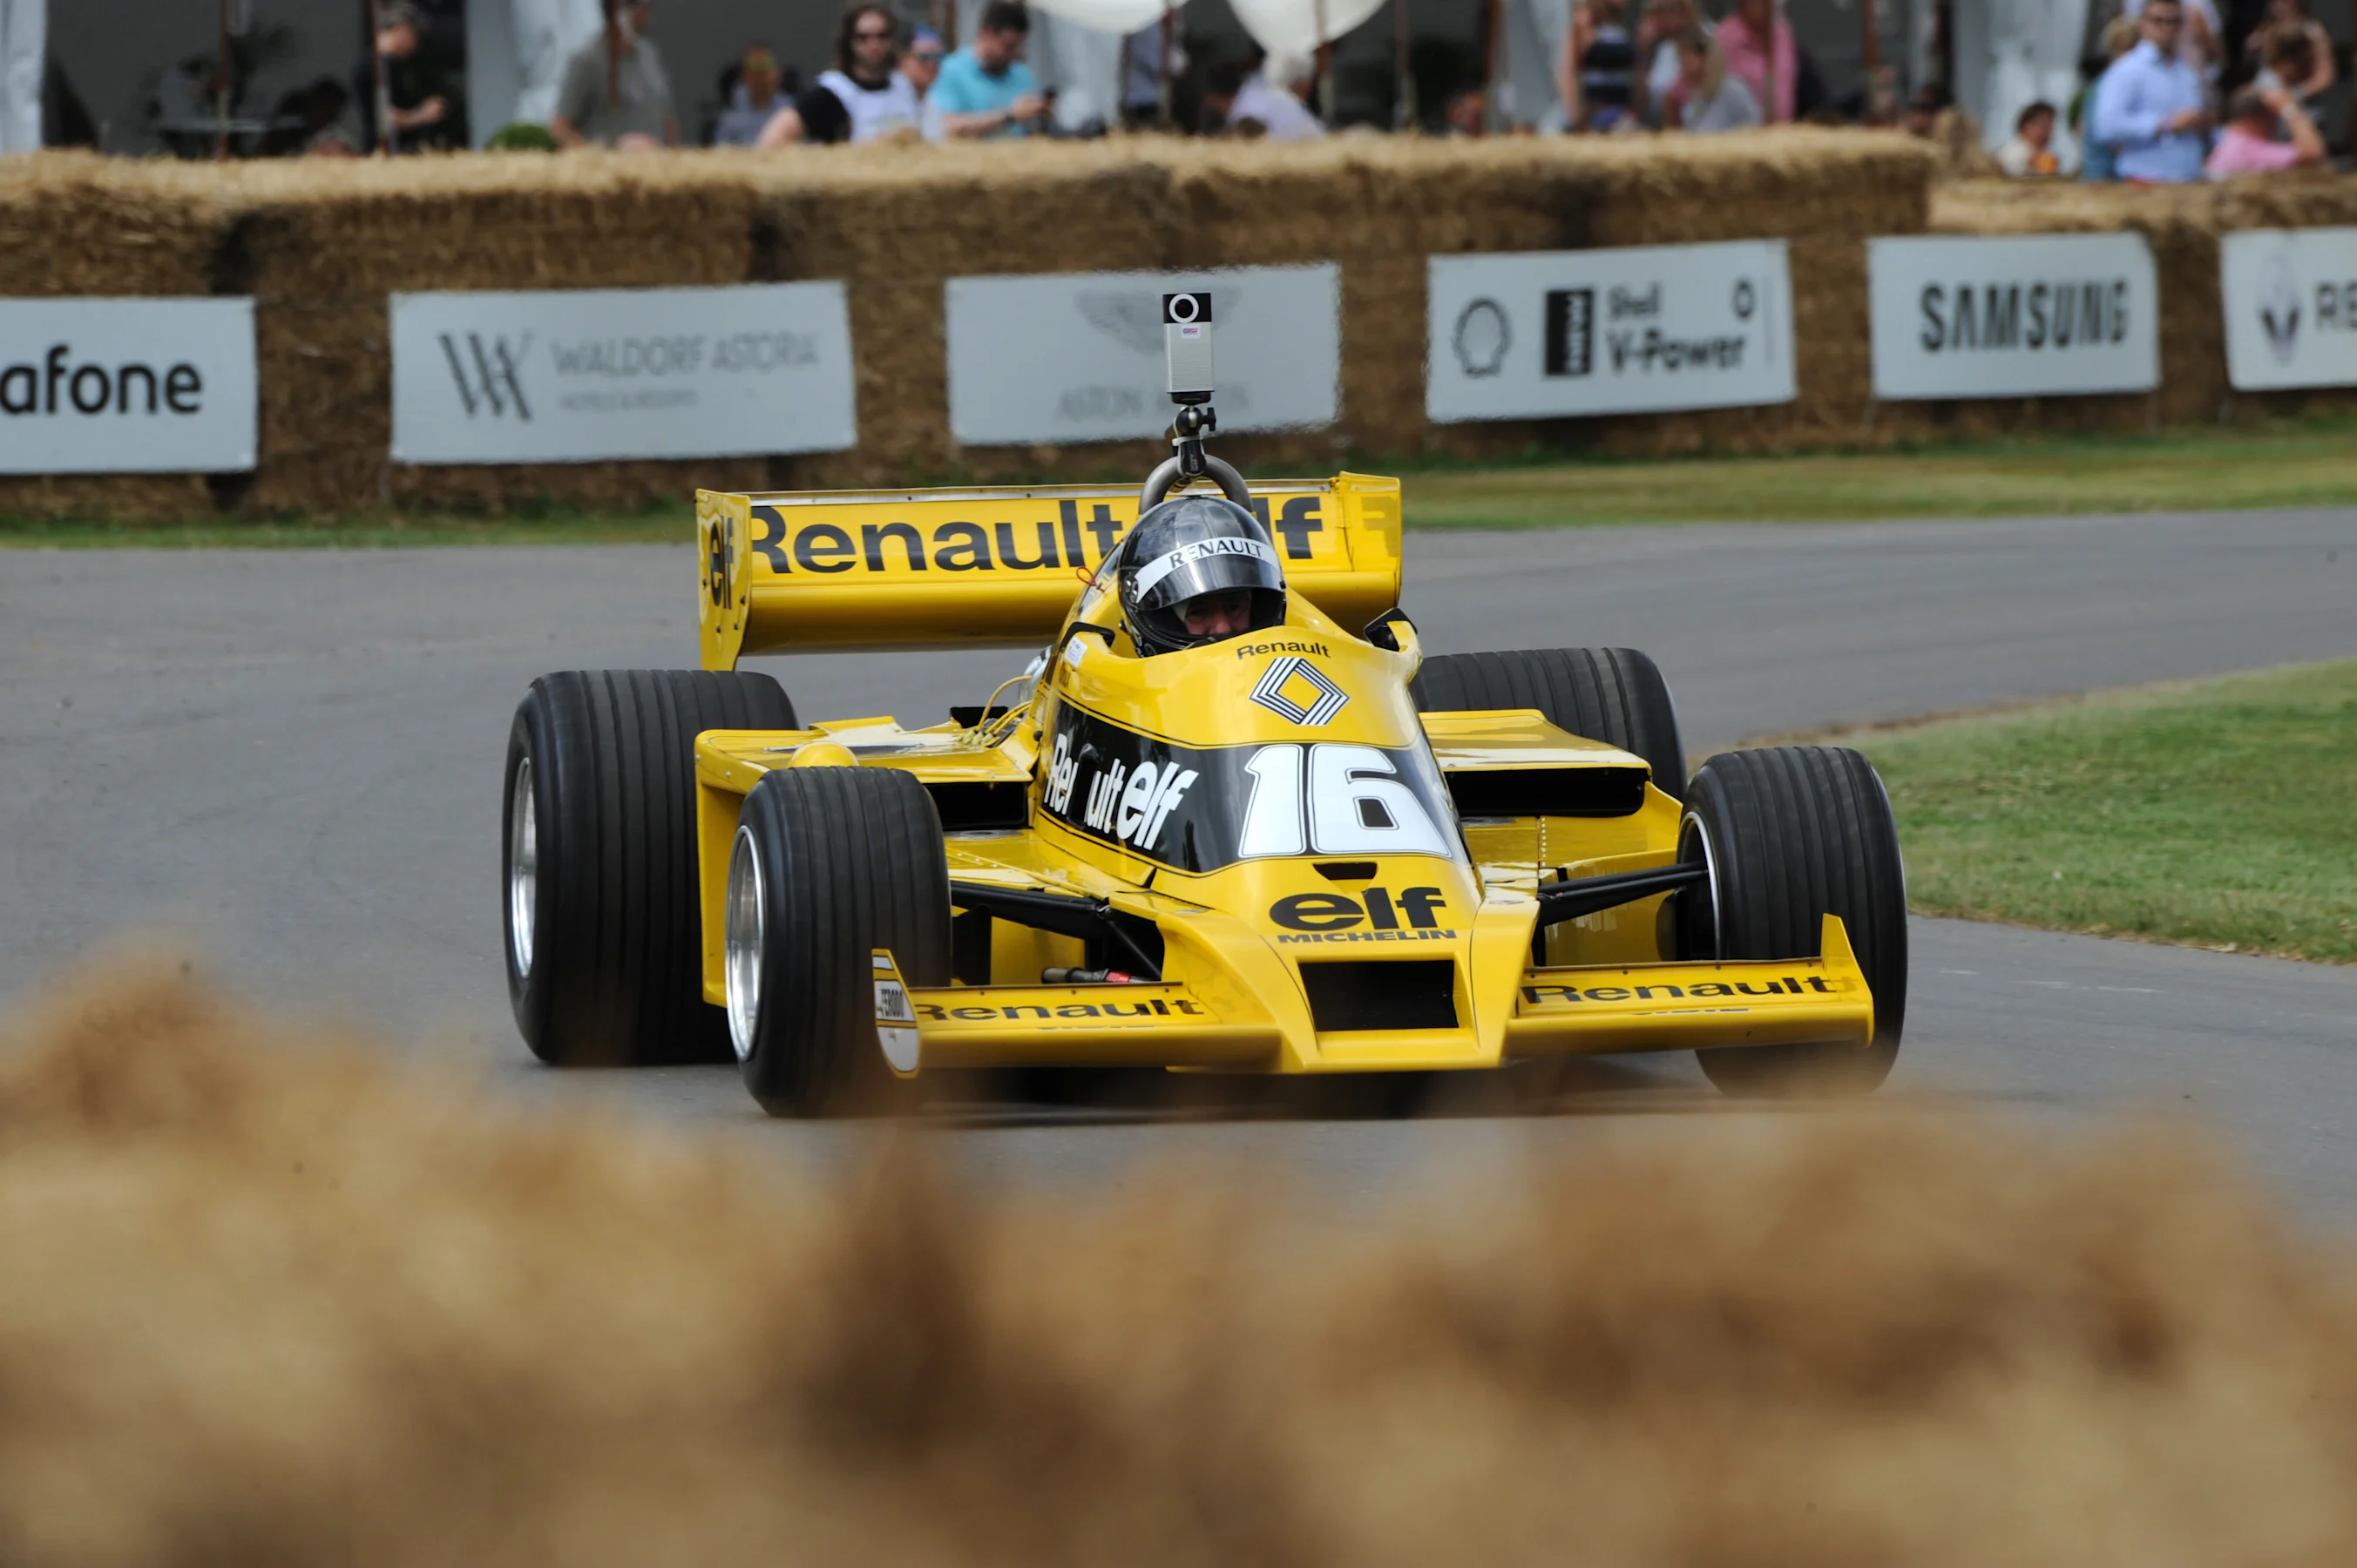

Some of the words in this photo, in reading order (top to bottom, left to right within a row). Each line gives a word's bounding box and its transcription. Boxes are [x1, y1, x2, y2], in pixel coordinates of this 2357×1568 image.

[1920, 280, 2128, 353] SAMSUNG
[710, 516, 733, 609] elf
[751, 500, 1122, 574] Renault
[1169, 539, 1263, 569] RENAULT
[1236, 641, 1331, 659] Renault
[1116, 760, 1199, 851] elf
[1238, 744, 1452, 858] 16
[1269, 887, 1447, 931] elf
[1277, 929, 1457, 943] MICHELIN
[1521, 977, 1837, 1004] Renault
